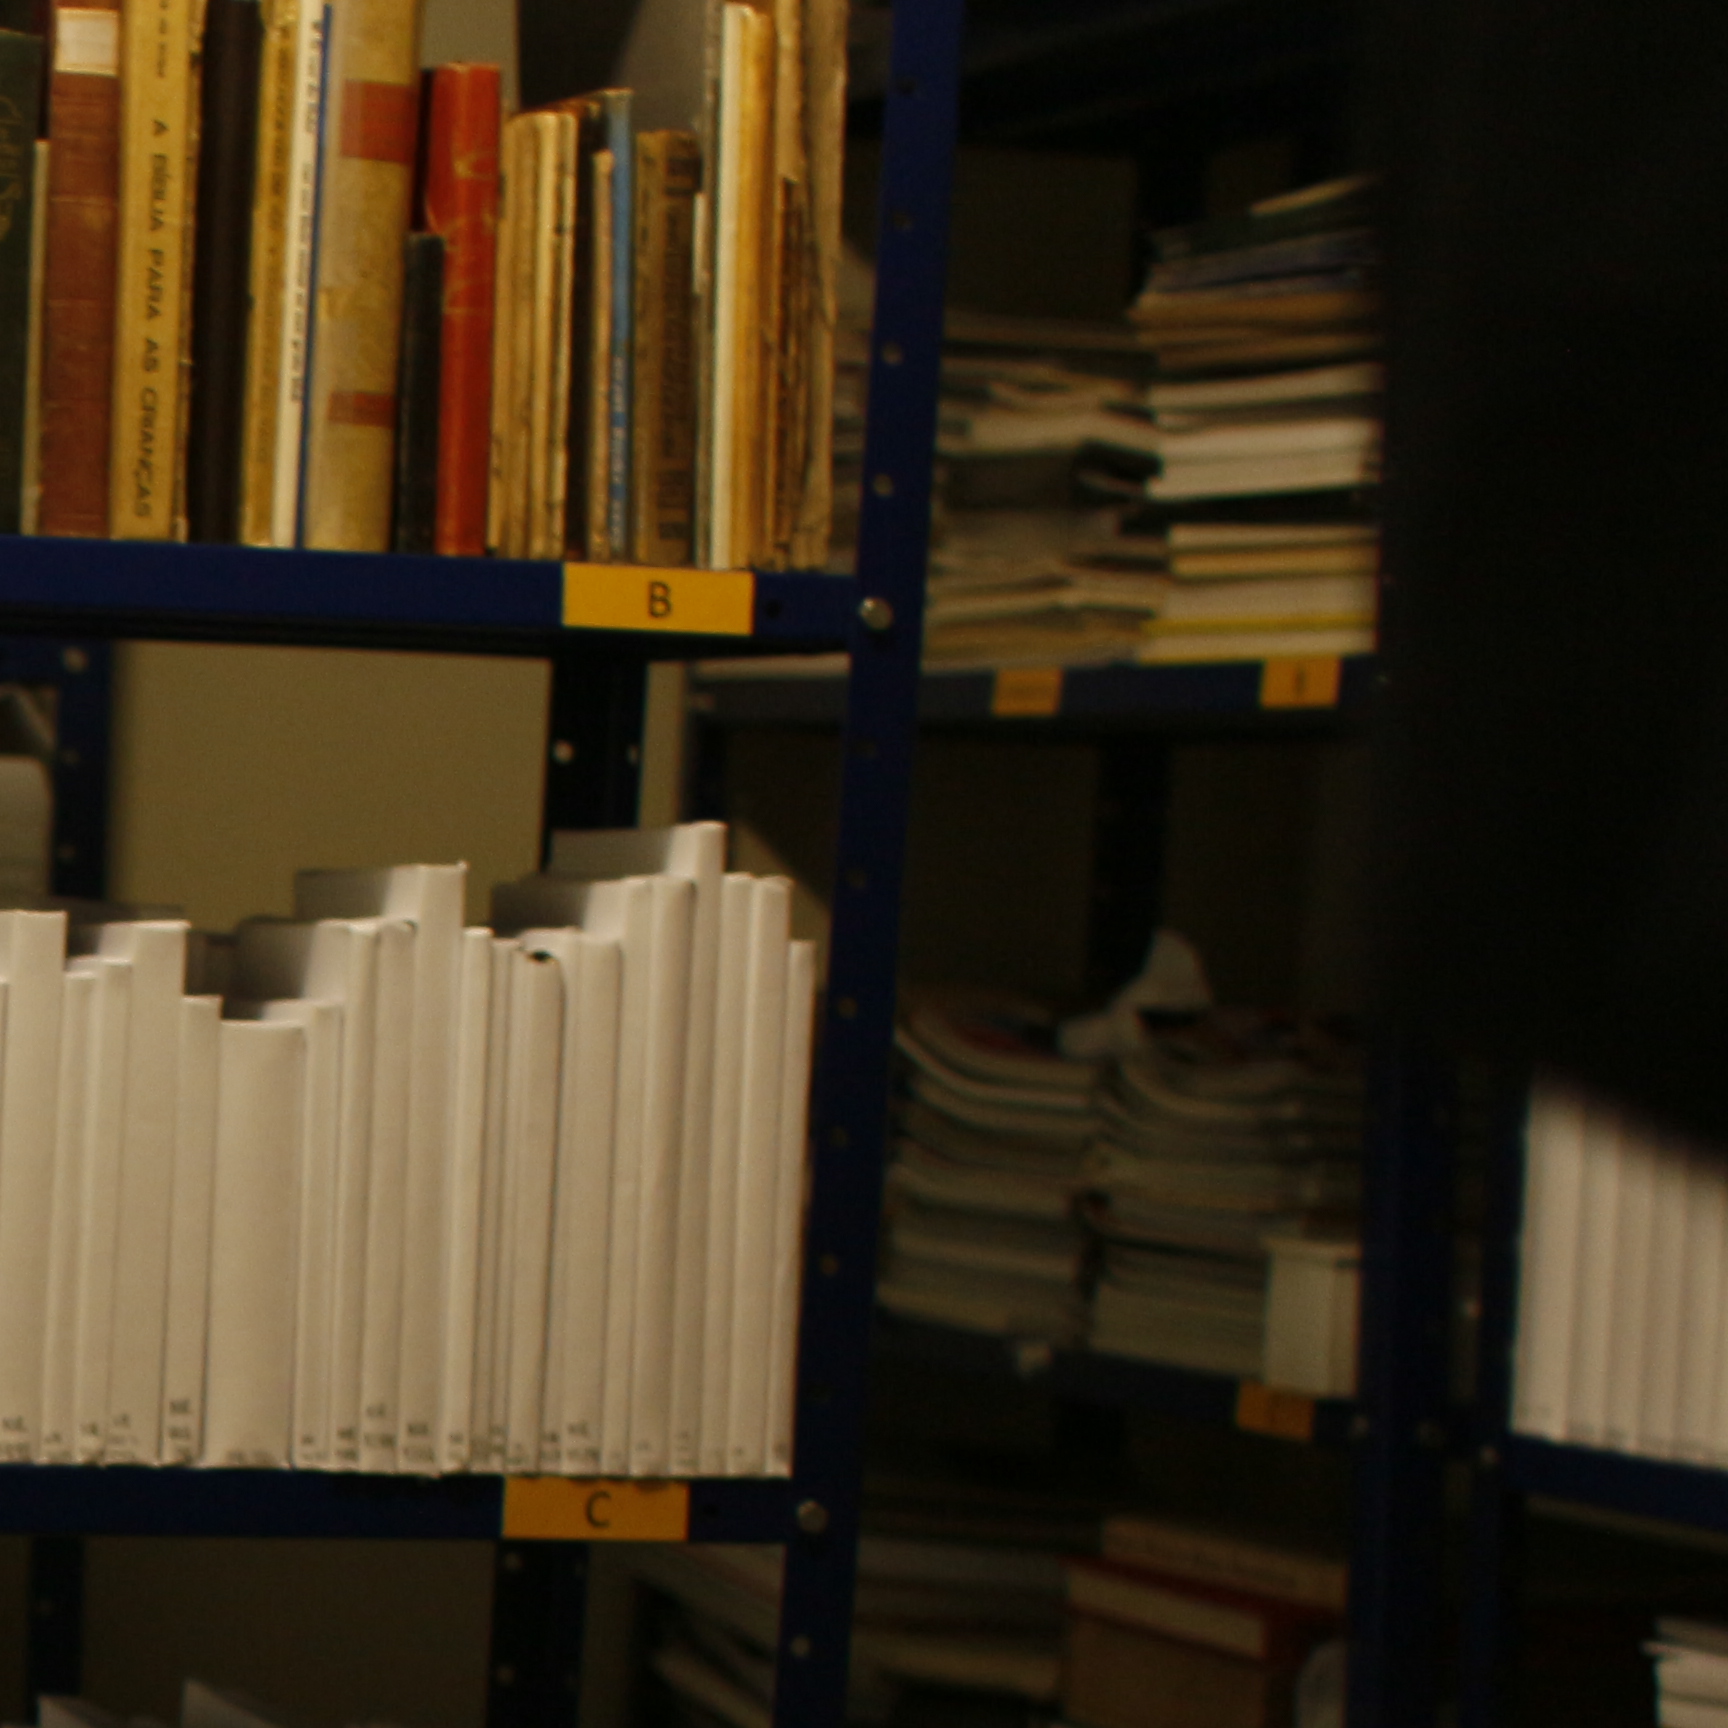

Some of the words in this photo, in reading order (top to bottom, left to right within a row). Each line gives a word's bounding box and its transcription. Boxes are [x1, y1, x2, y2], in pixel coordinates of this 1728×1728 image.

[151, 118, 168, 138] A
[149, 153, 171, 232] BÍBLIA
[145, 248, 165, 320] PARA
[143, 338, 160, 372] AS
[134, 387, 158, 519] CRIANÇAS
[648, 582, 672, 616] B
[584, 1494, 611, 1530] C
